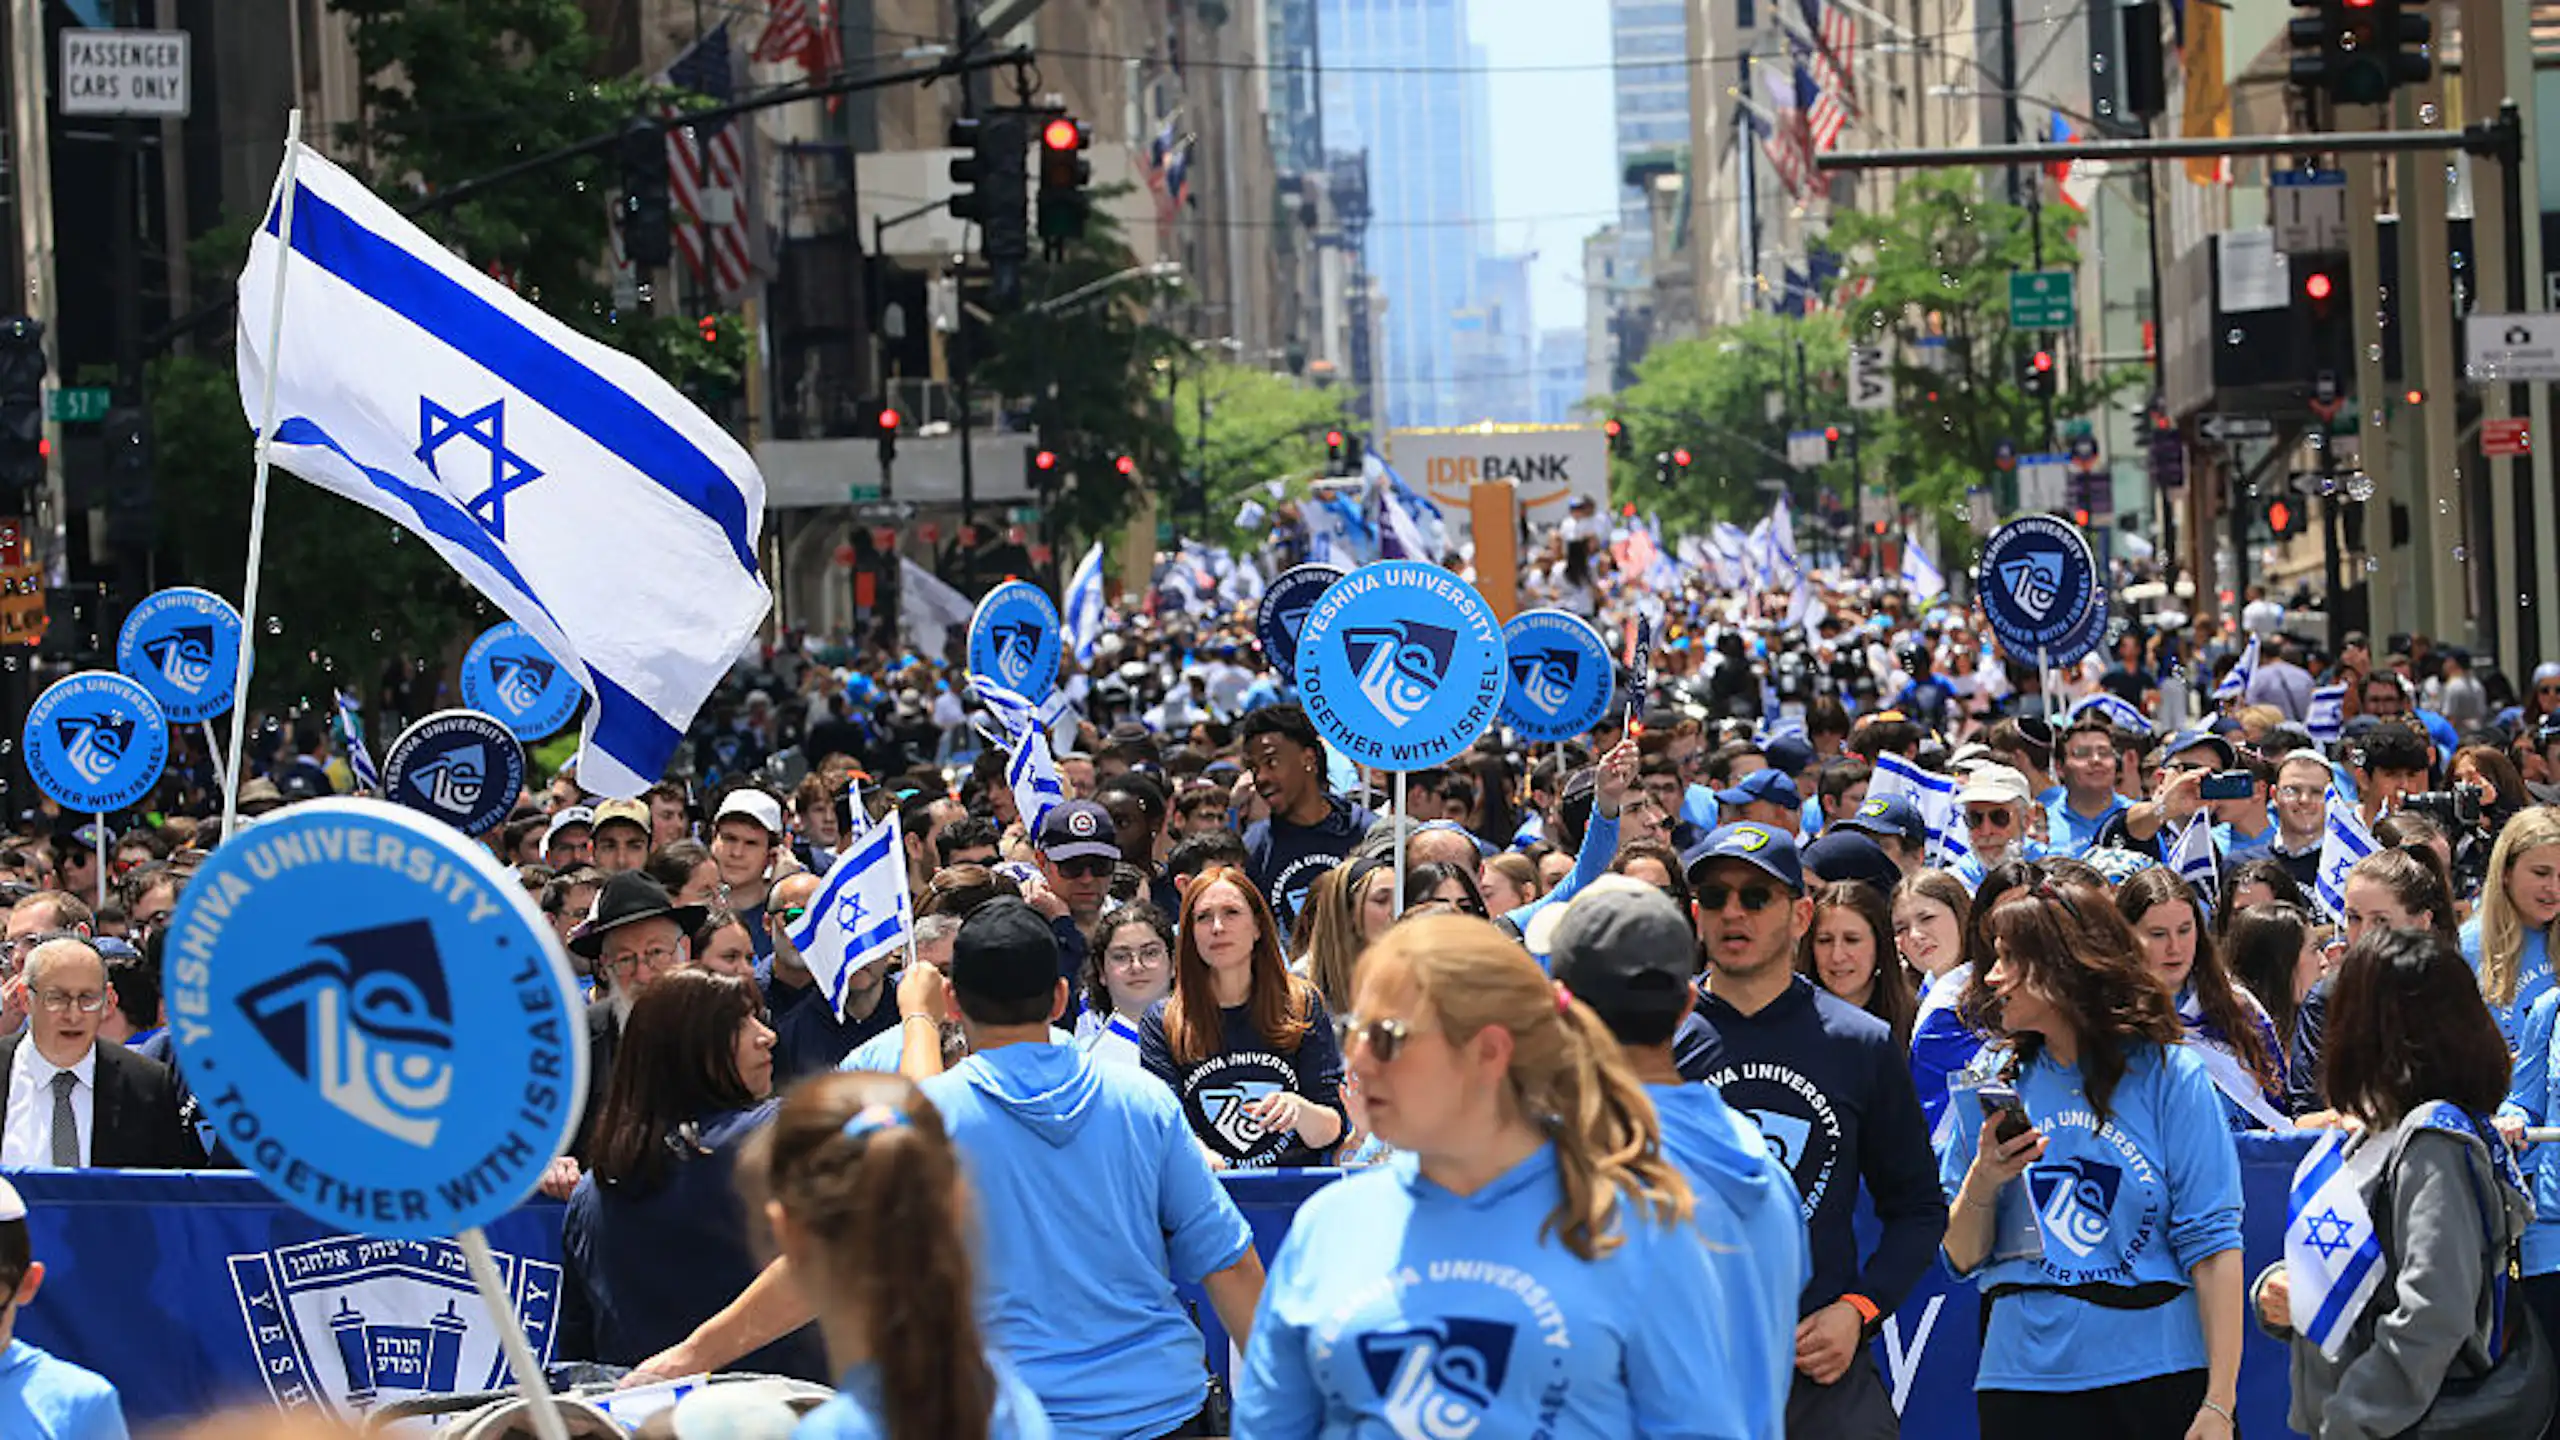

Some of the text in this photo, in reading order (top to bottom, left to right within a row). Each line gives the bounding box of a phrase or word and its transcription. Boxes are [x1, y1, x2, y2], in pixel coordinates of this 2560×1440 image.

[70, 42, 179, 68] PASSENGER
[70, 76, 179, 100] CARS ONLY
[2016, 519, 2083, 560] UNIVERSITY
[1304, 568, 1496, 643] YESHIVA UNIVERSITY
[31, 678, 161, 731] YESHIVA UNIVERSITY
[1303, 665, 1498, 761] TOGETHER WITH ISRAEL
[29, 740, 164, 807] TOGETHER WITH ISRAEL
[387, 718, 509, 793] YESHIVA UNIVERSITY
[175, 826, 502, 1046] YESHIVA UNIVERSITY
[212, 954, 563, 1223] TOGETHER WITH ISRAEL
[1741, 1063, 1842, 1138] UNIVERSITY
[2057, 1109, 2156, 1184] UNIVERSITY
[1800, 1156, 1837, 1221] SRAEL
[1429, 1259, 1572, 1349] UNIVERSITY
[250, 1290, 308, 1410] YESH
[376, 1336, 422, 1355] תורה
